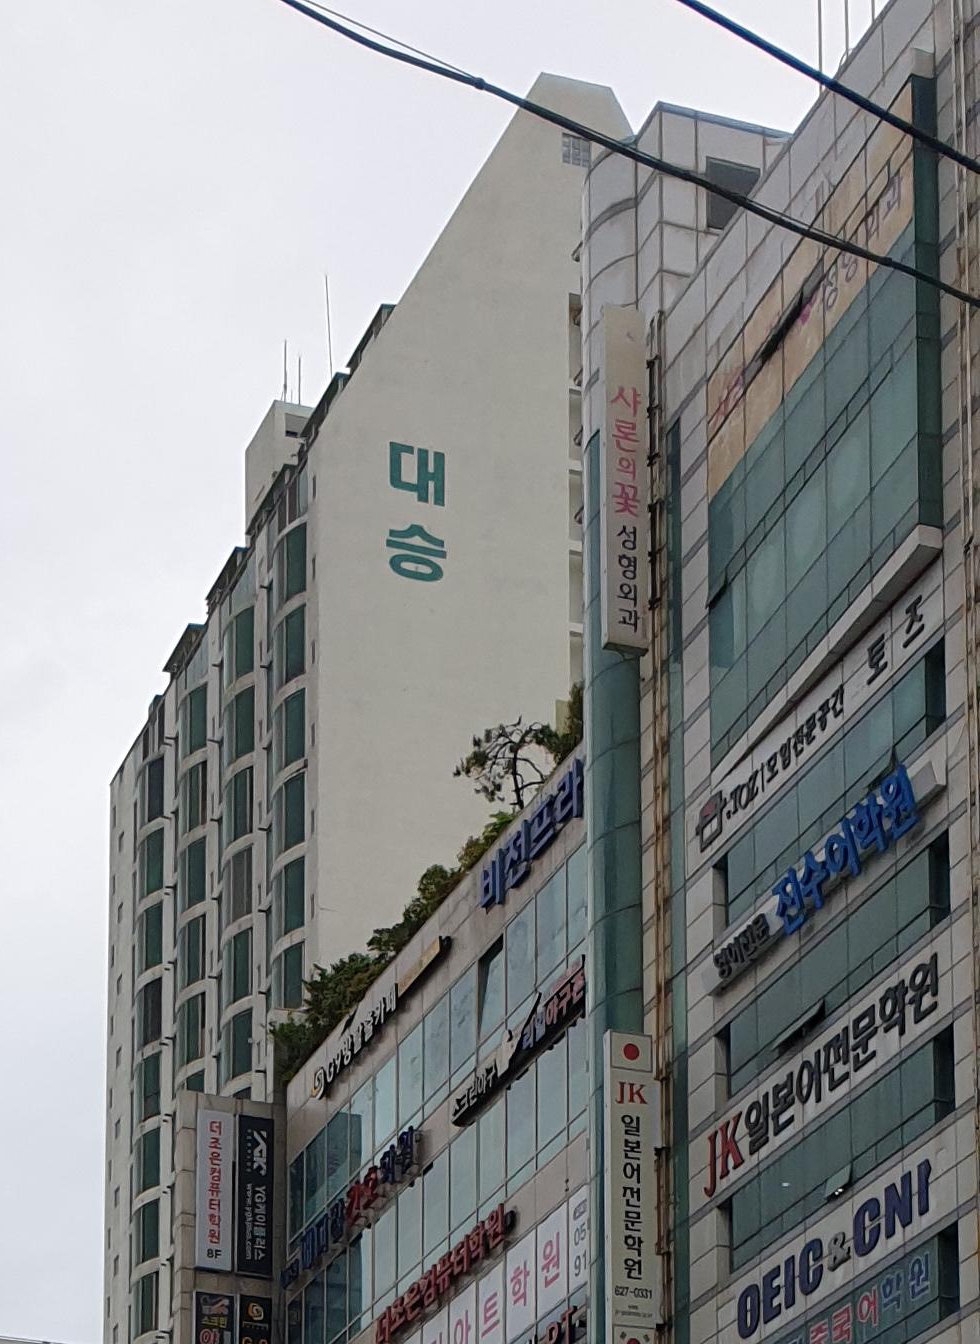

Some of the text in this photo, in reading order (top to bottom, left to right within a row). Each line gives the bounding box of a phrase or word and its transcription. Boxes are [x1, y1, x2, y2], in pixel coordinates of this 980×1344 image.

[386, 441, 447, 583] 대승
[617, 523, 640, 633] 성형외과
[614, 1081, 647, 1106] JK
[620, 1114, 643, 1281] 일본어전문학원
